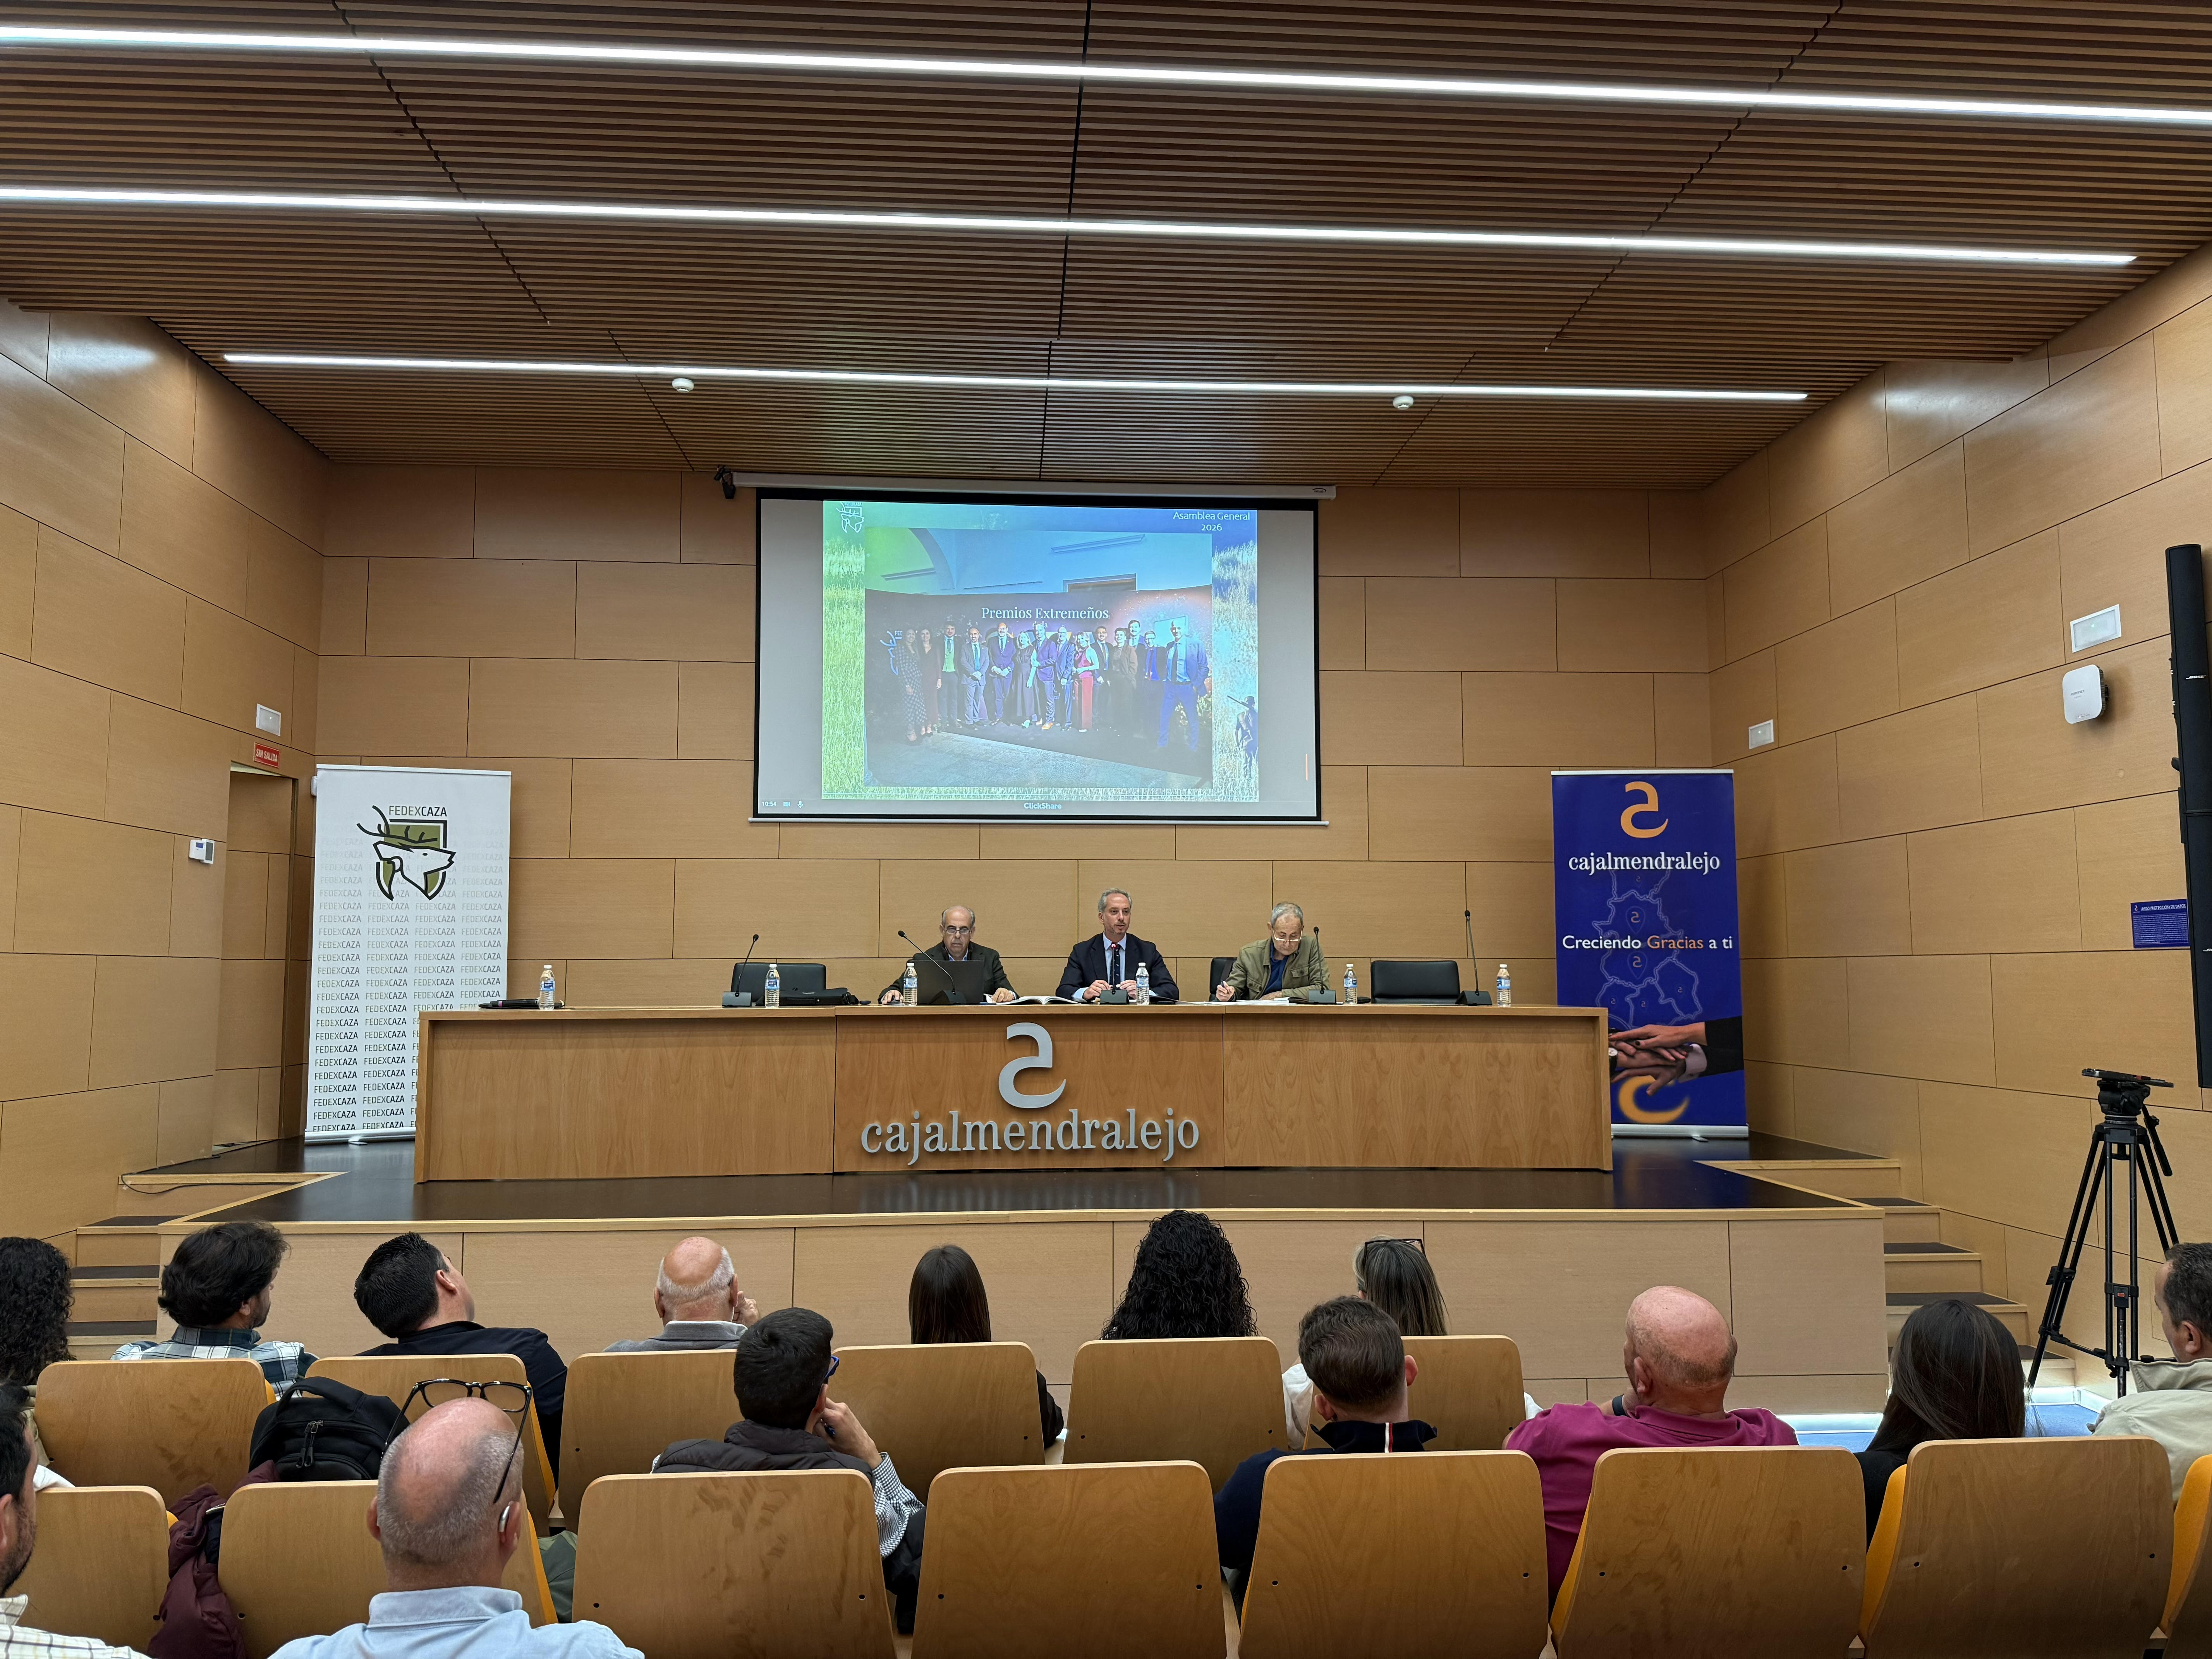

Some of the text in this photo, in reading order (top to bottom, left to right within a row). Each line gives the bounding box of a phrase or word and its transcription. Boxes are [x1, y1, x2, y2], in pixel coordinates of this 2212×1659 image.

[1173, 511, 1250, 520] Asamblea General
[982, 607, 1109, 619] Premios Extremeños
[264, 750, 278, 763] SALIDA
[389, 805, 447, 817] FEDEXCAZA
[1568, 852, 1720, 876] cajalmendralejo
[1562, 935, 1733, 949] Creciendo Gracias a ti
[364, 1056, 405, 1065] FEDEXCAZA
[315, 1071, 357, 1080] FEDEXCAZA
[314, 1084, 357, 1092] FEDEXCAZA
[364, 1082, 405, 1091] FEDEXCAZA
[314, 1097, 356, 1106] FEDEXCAZA
[363, 1096, 404, 1104] FEDEXCAZA
[314, 1111, 356, 1119] FEDEXCAZA
[363, 1108, 404, 1117] FEDEXCAZA
[861, 1108, 1200, 1166] cajalmendralejo
